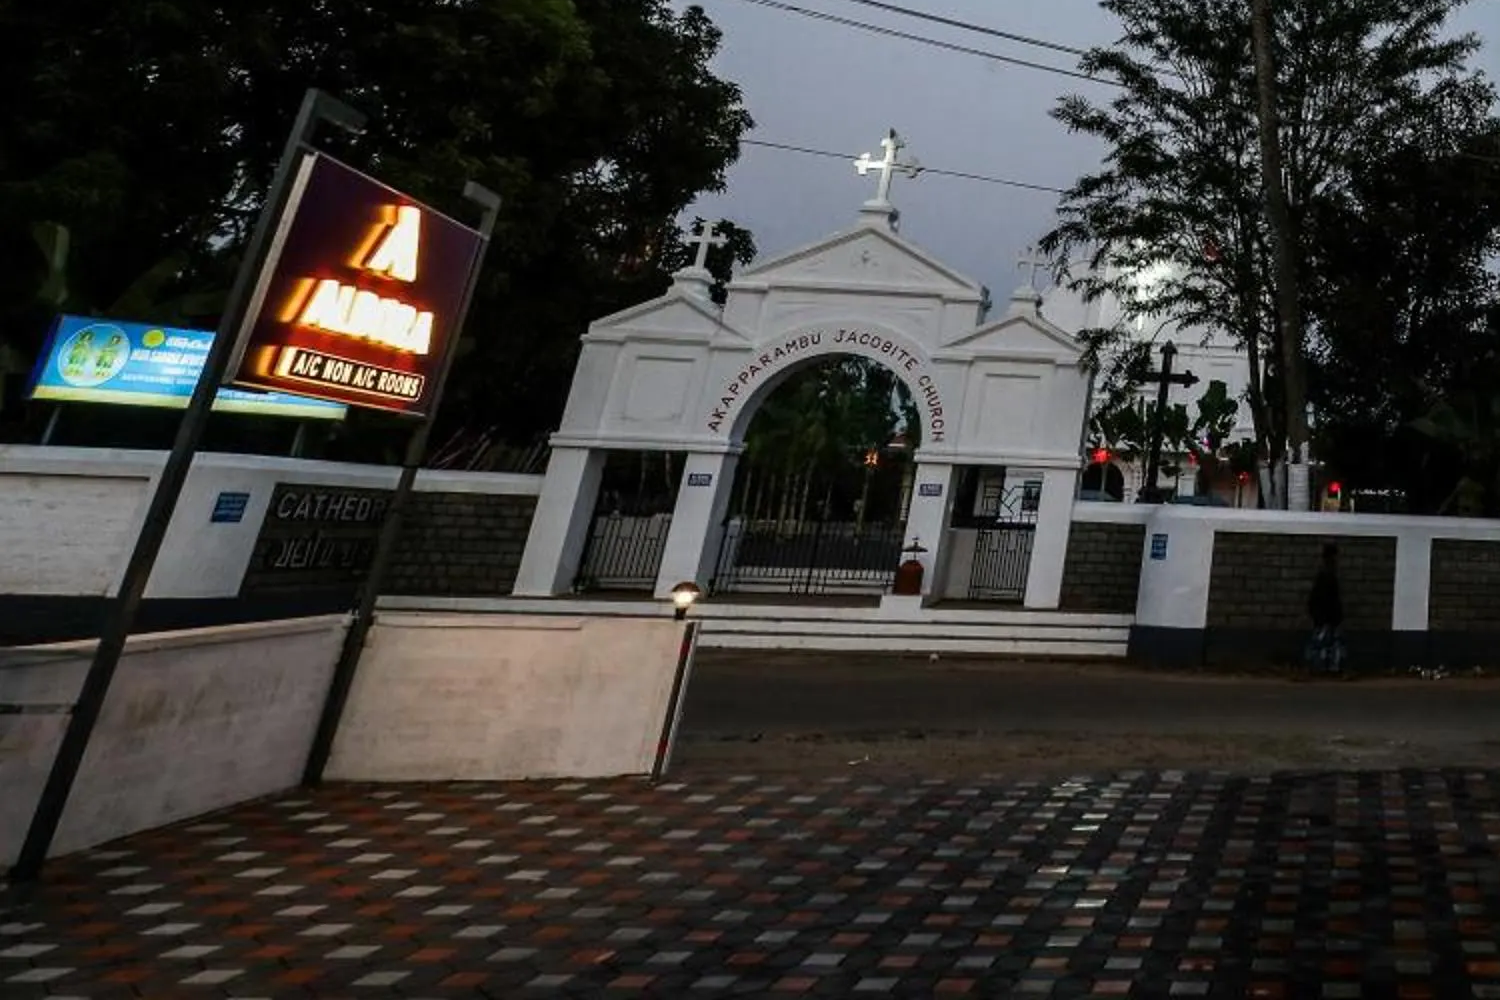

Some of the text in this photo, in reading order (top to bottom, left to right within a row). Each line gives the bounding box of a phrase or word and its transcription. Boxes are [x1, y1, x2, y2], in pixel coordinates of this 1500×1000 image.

[293, 353, 420, 396] A/C NON A/C ROOMS
[708, 329, 945, 442] AKAPPARAMBU JACOBITE CHURCH
[276, 492, 389, 521] CATHEDR
